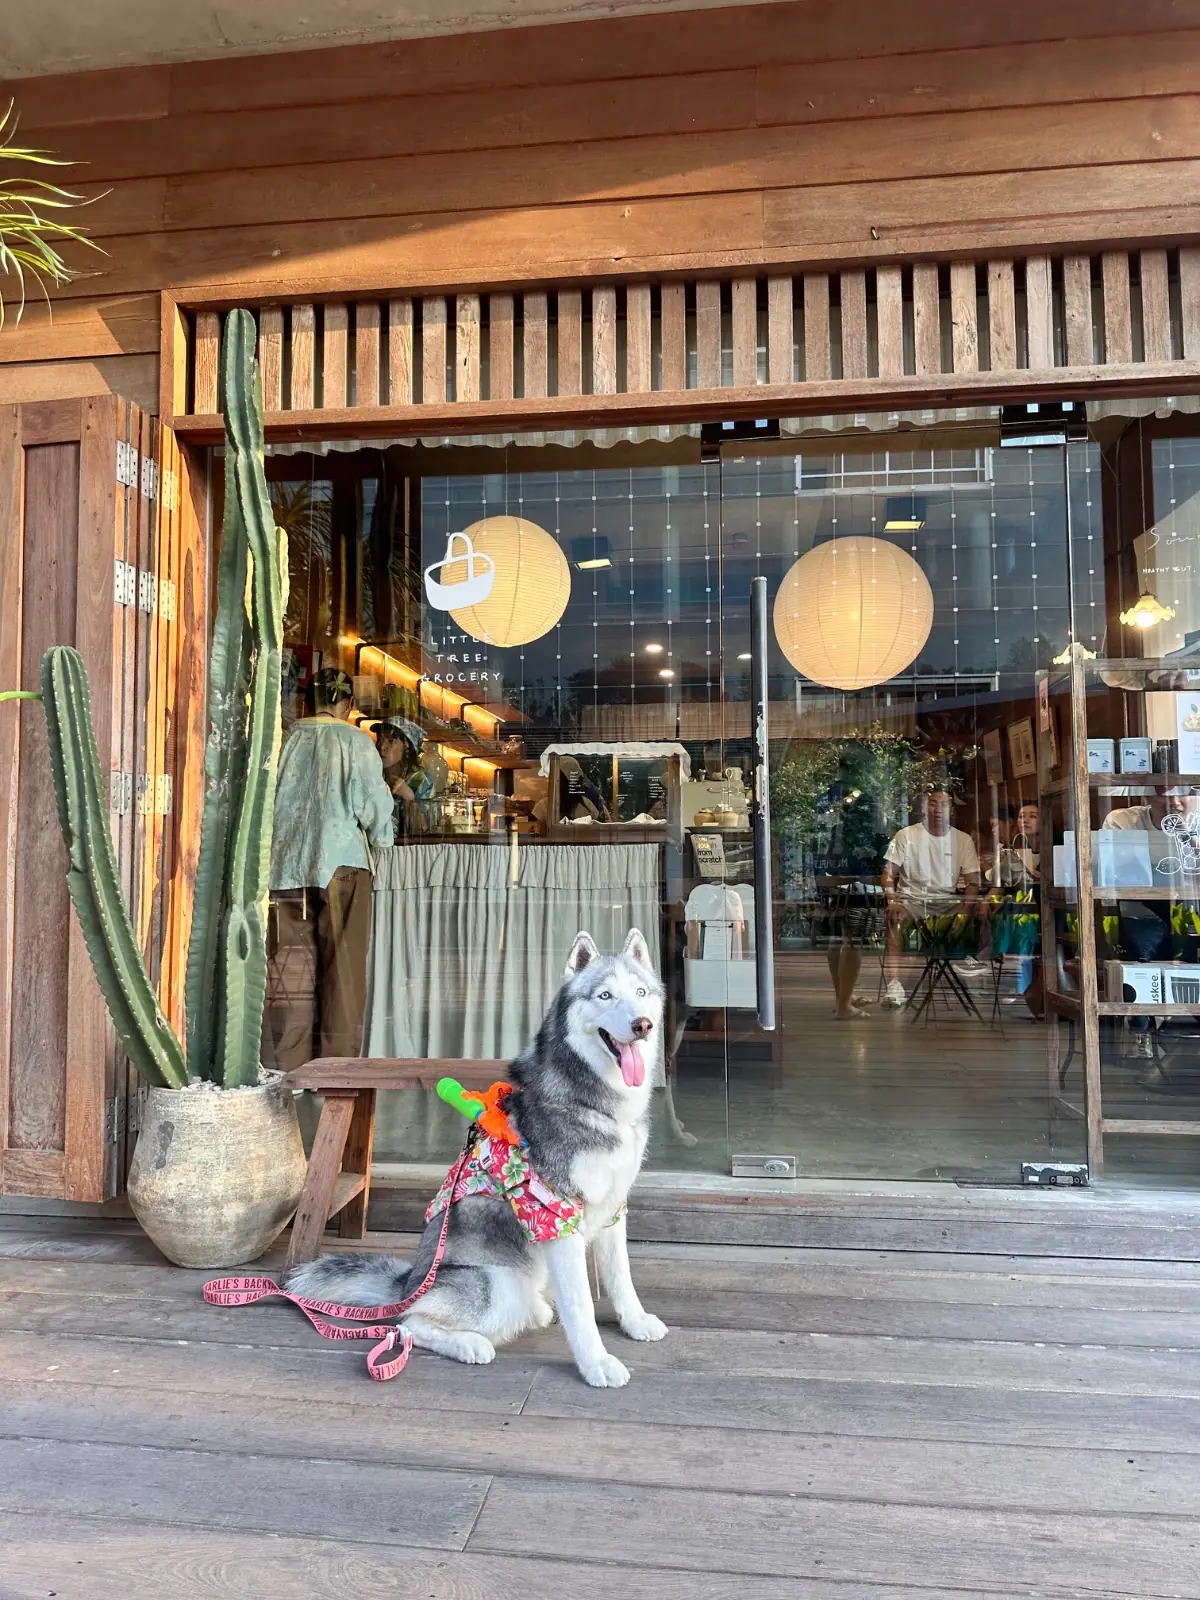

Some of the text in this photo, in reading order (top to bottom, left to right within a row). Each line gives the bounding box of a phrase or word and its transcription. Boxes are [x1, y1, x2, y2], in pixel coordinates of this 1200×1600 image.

[431, 632, 489, 645] LITTLE
[436, 653, 482, 663] TREE
[421, 672, 500, 683] GROCERY
[298, 1296, 341, 1315] CHARLIE'S
[343, 1307, 379, 1319] BACKYARD
